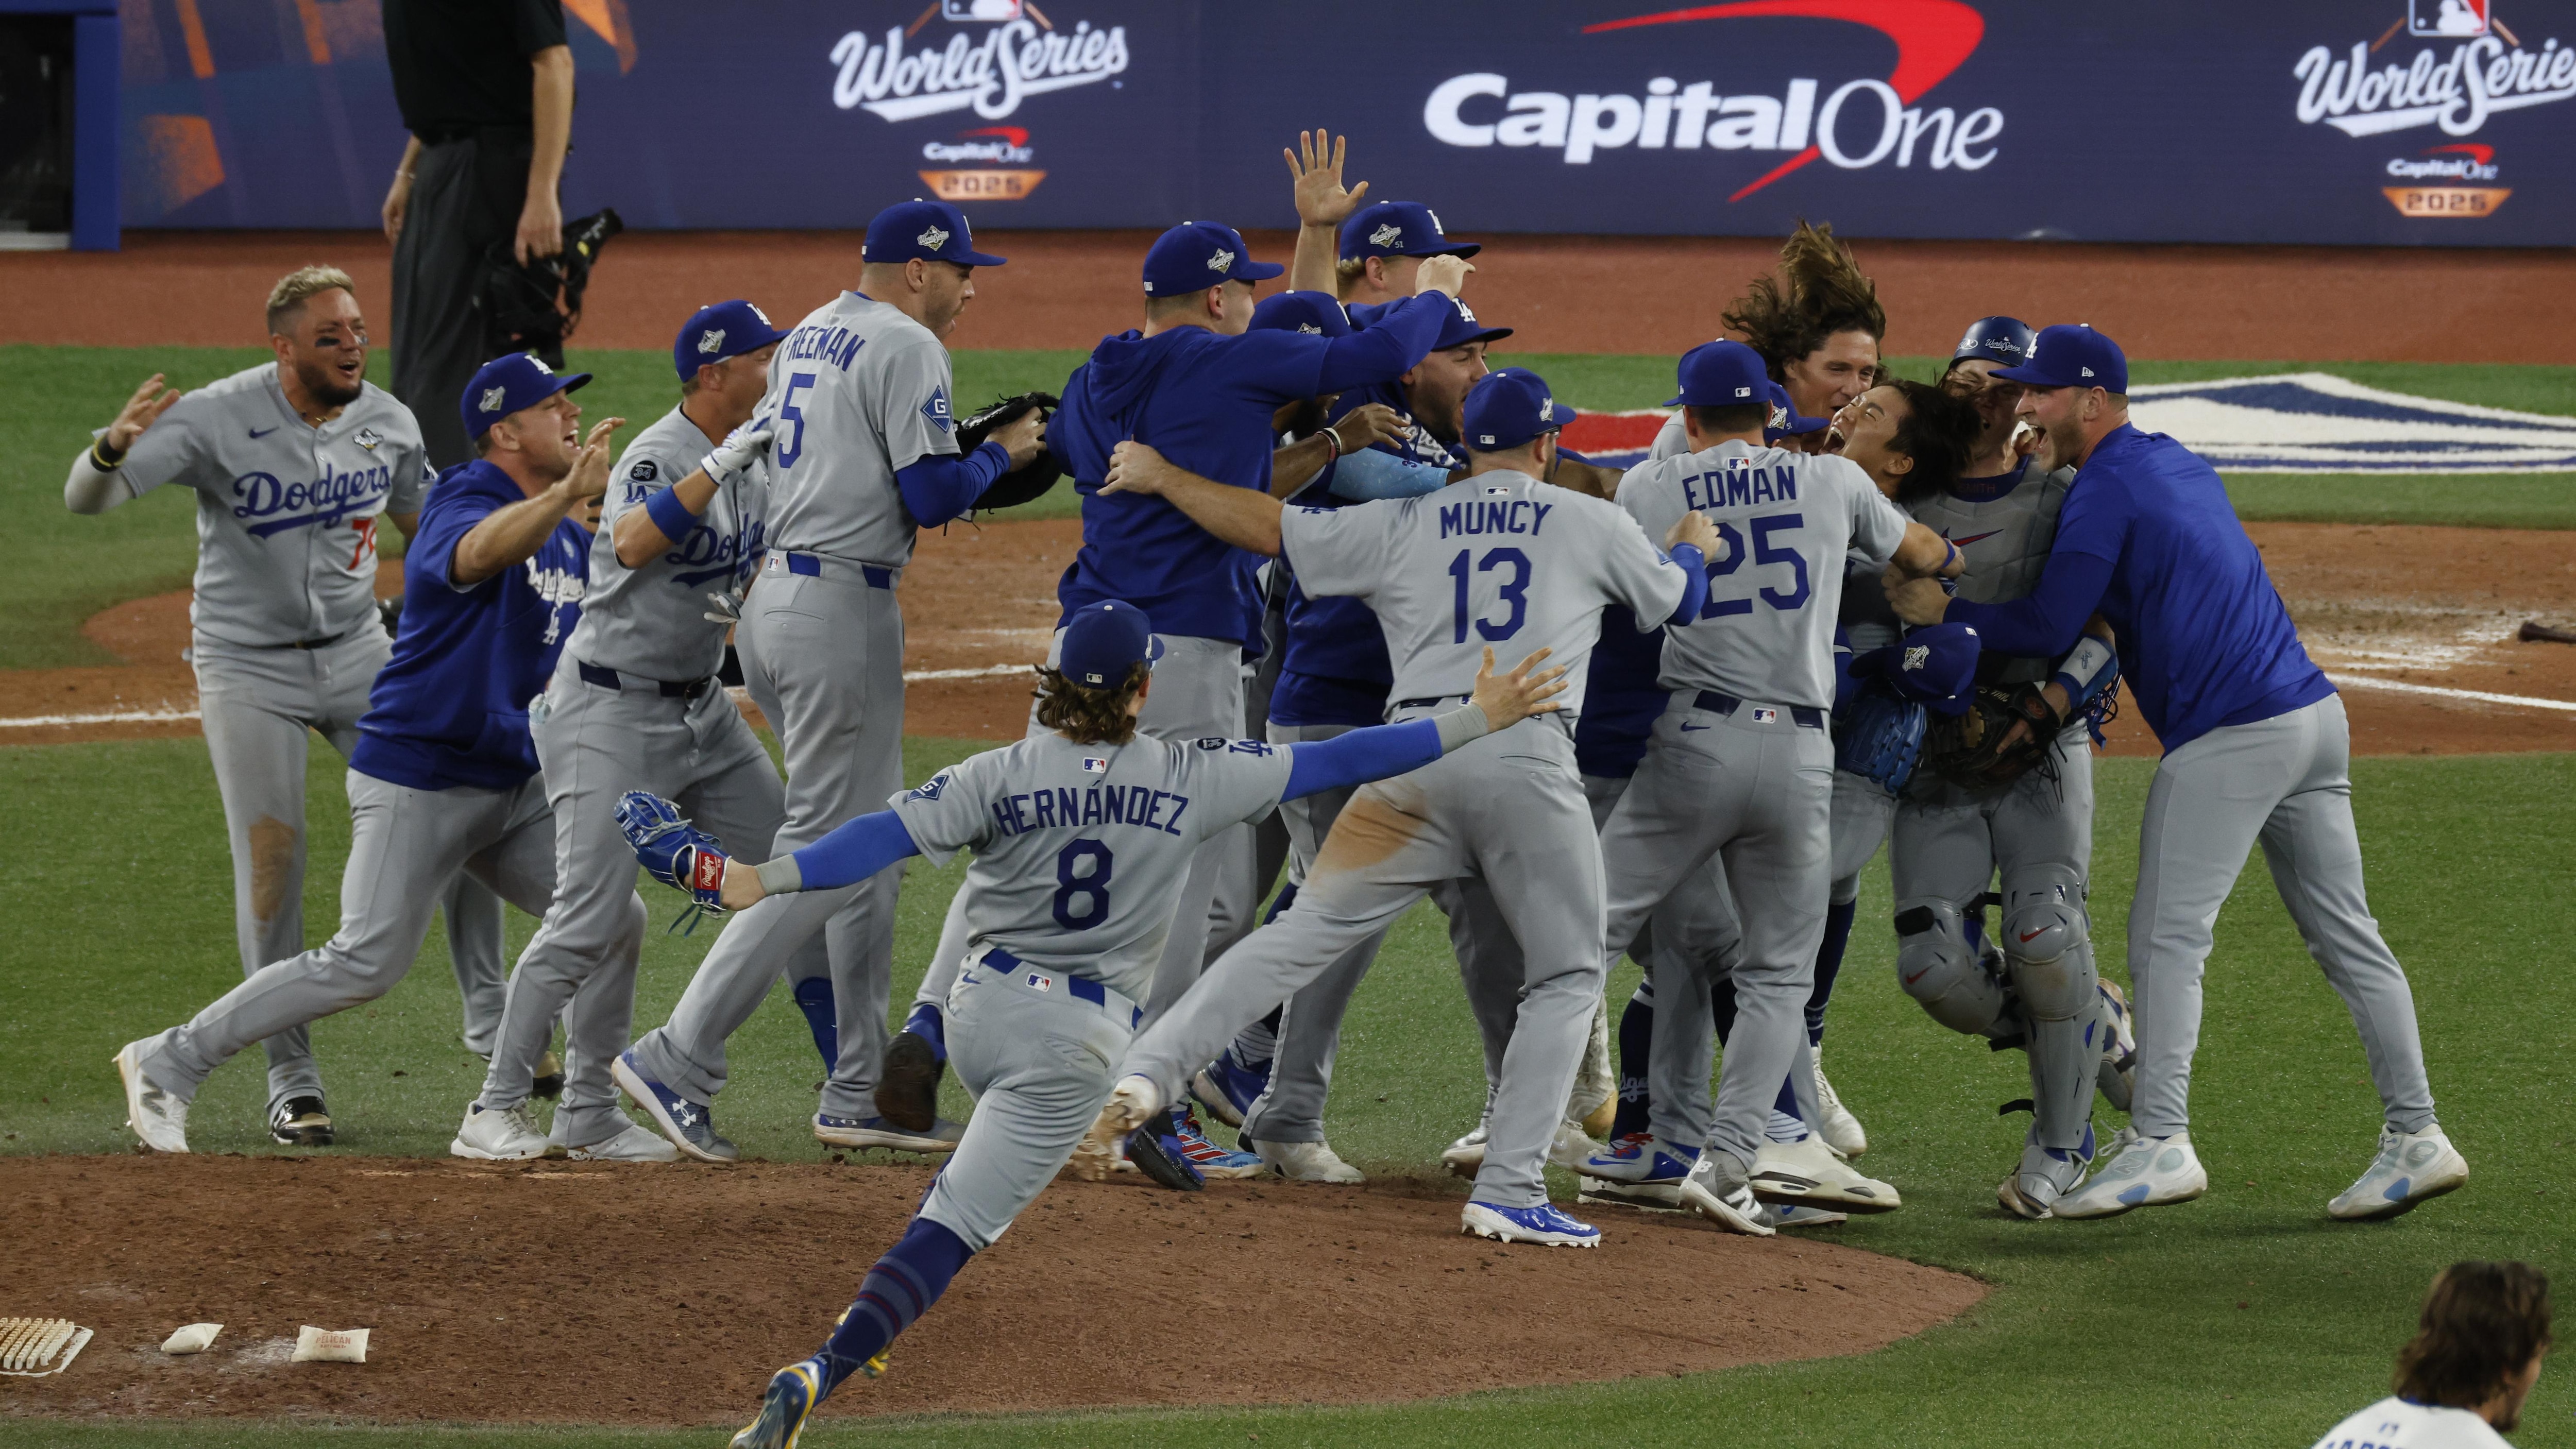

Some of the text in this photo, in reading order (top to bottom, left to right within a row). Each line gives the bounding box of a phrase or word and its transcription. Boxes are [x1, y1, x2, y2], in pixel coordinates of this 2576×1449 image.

[2438, 36, 2576, 136] Serie
[2406, 193, 2486, 211] 2025
[1452, 298, 1476, 322] LA
[785, 326, 866, 372] FREEMAN
[1985, 338, 2021, 352] World Series
[778, 373, 816, 468] 5
[935, 399, 946, 413] G
[234, 464, 392, 529] Dodgers
[634, 468, 651, 479] 34
[1683, 466, 1797, 512] EDMAN
[1440, 501, 1552, 539] MUNCY
[1701, 513, 1810, 620] 25
[1449, 548, 1532, 644] 13
[991, 779, 1189, 837] HERNÁNDEZ
[1053, 838, 1113, 930] 8
[316, 1336, 351, 1345] PELICAN
